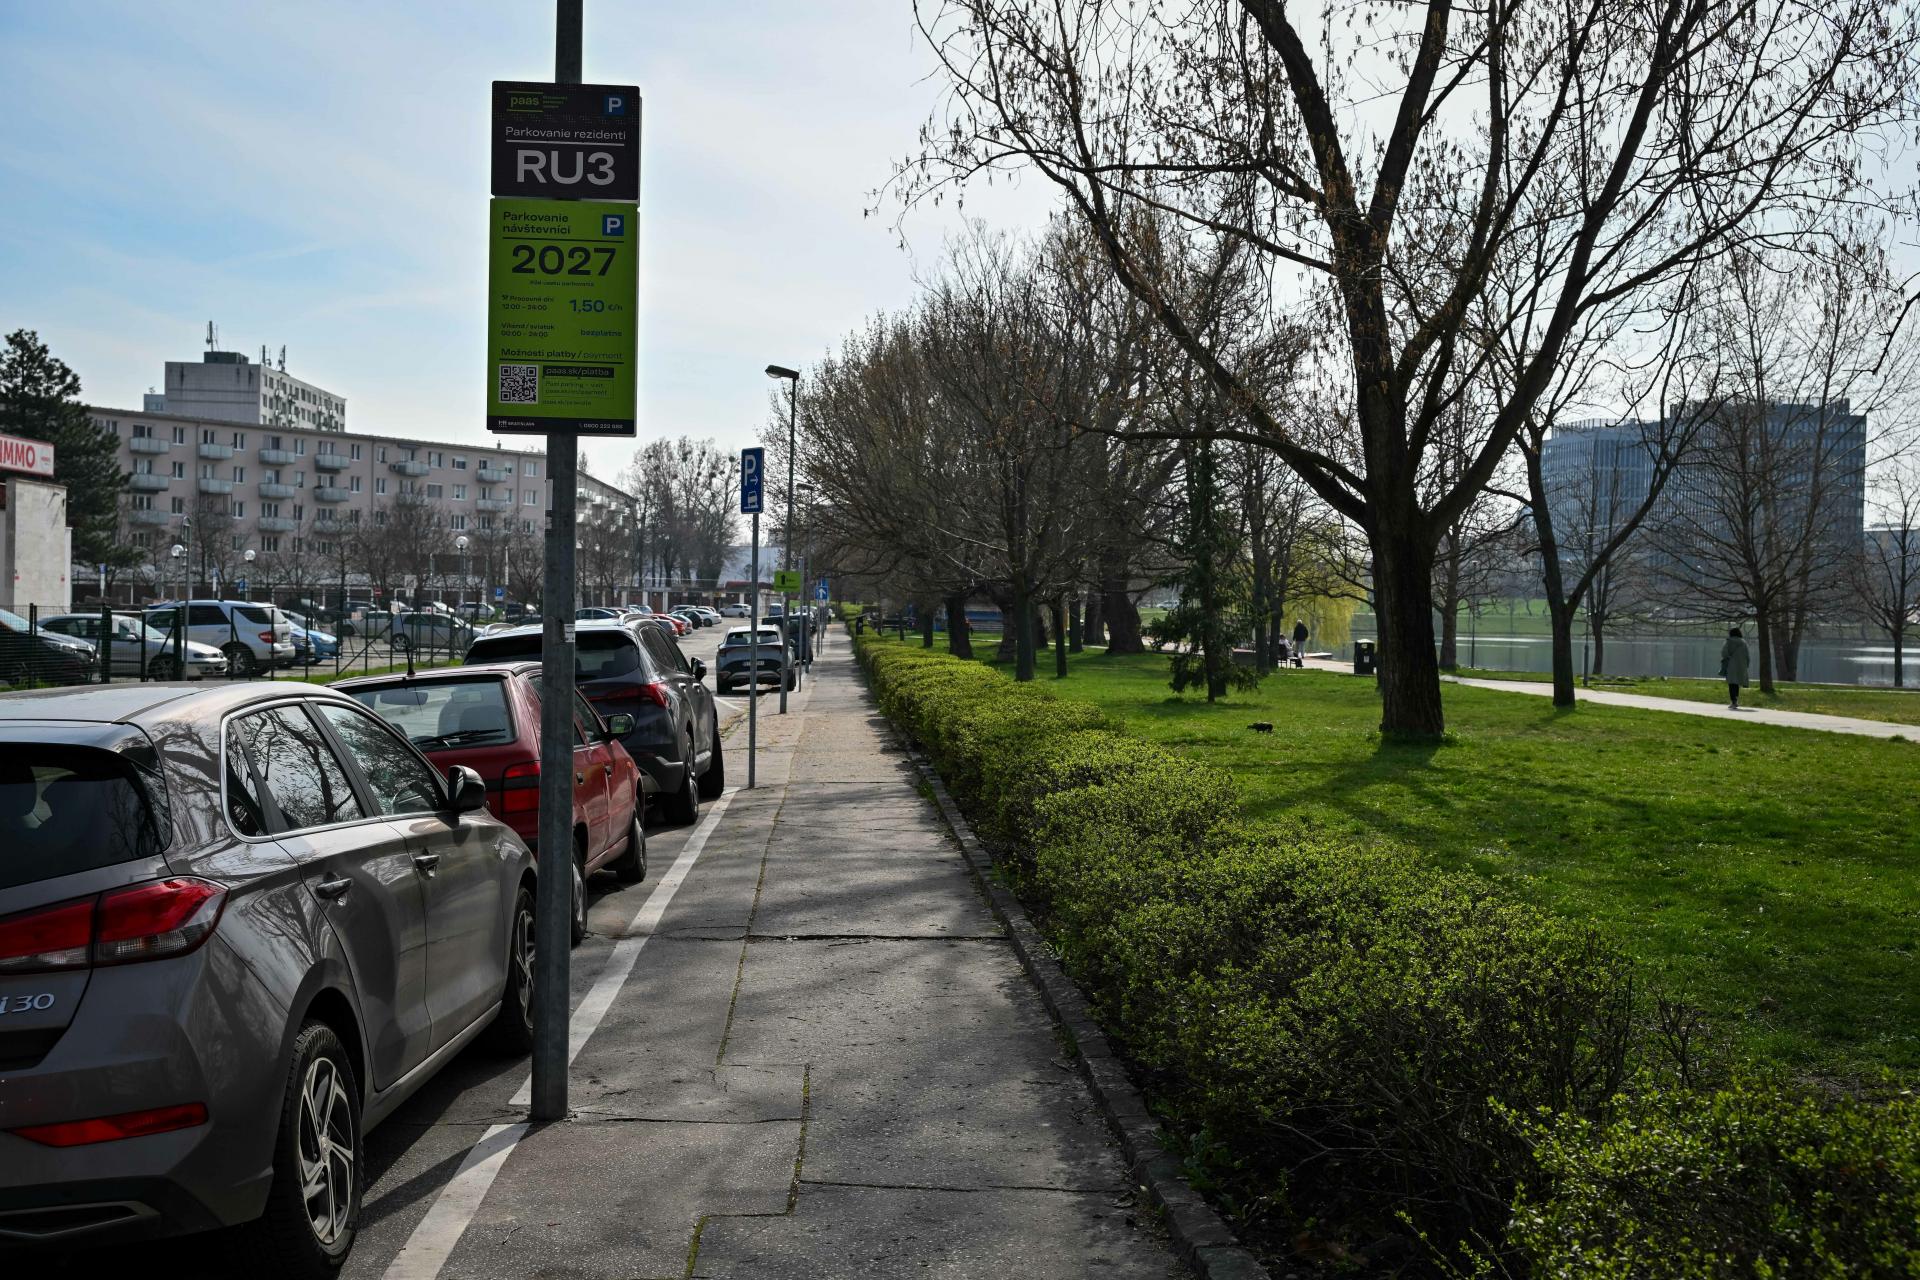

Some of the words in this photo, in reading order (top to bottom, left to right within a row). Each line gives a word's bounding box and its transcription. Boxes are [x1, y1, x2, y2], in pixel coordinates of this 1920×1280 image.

[511, 95, 539, 107] paas
[608, 97, 622, 113] P
[505, 127, 571, 138] Parkovanie
[574, 129, 626, 140] rezidenti
[516, 149, 616, 186] RU3
[503, 211, 569, 223] Parkovanie
[502, 223, 571, 235] návštevníci
[606, 217, 621, 233] P
[511, 244, 617, 276] 2027
[501, 347, 545, 358] Možnosti
[546, 350, 576, 360] platby
[744, 454, 757, 487] P
